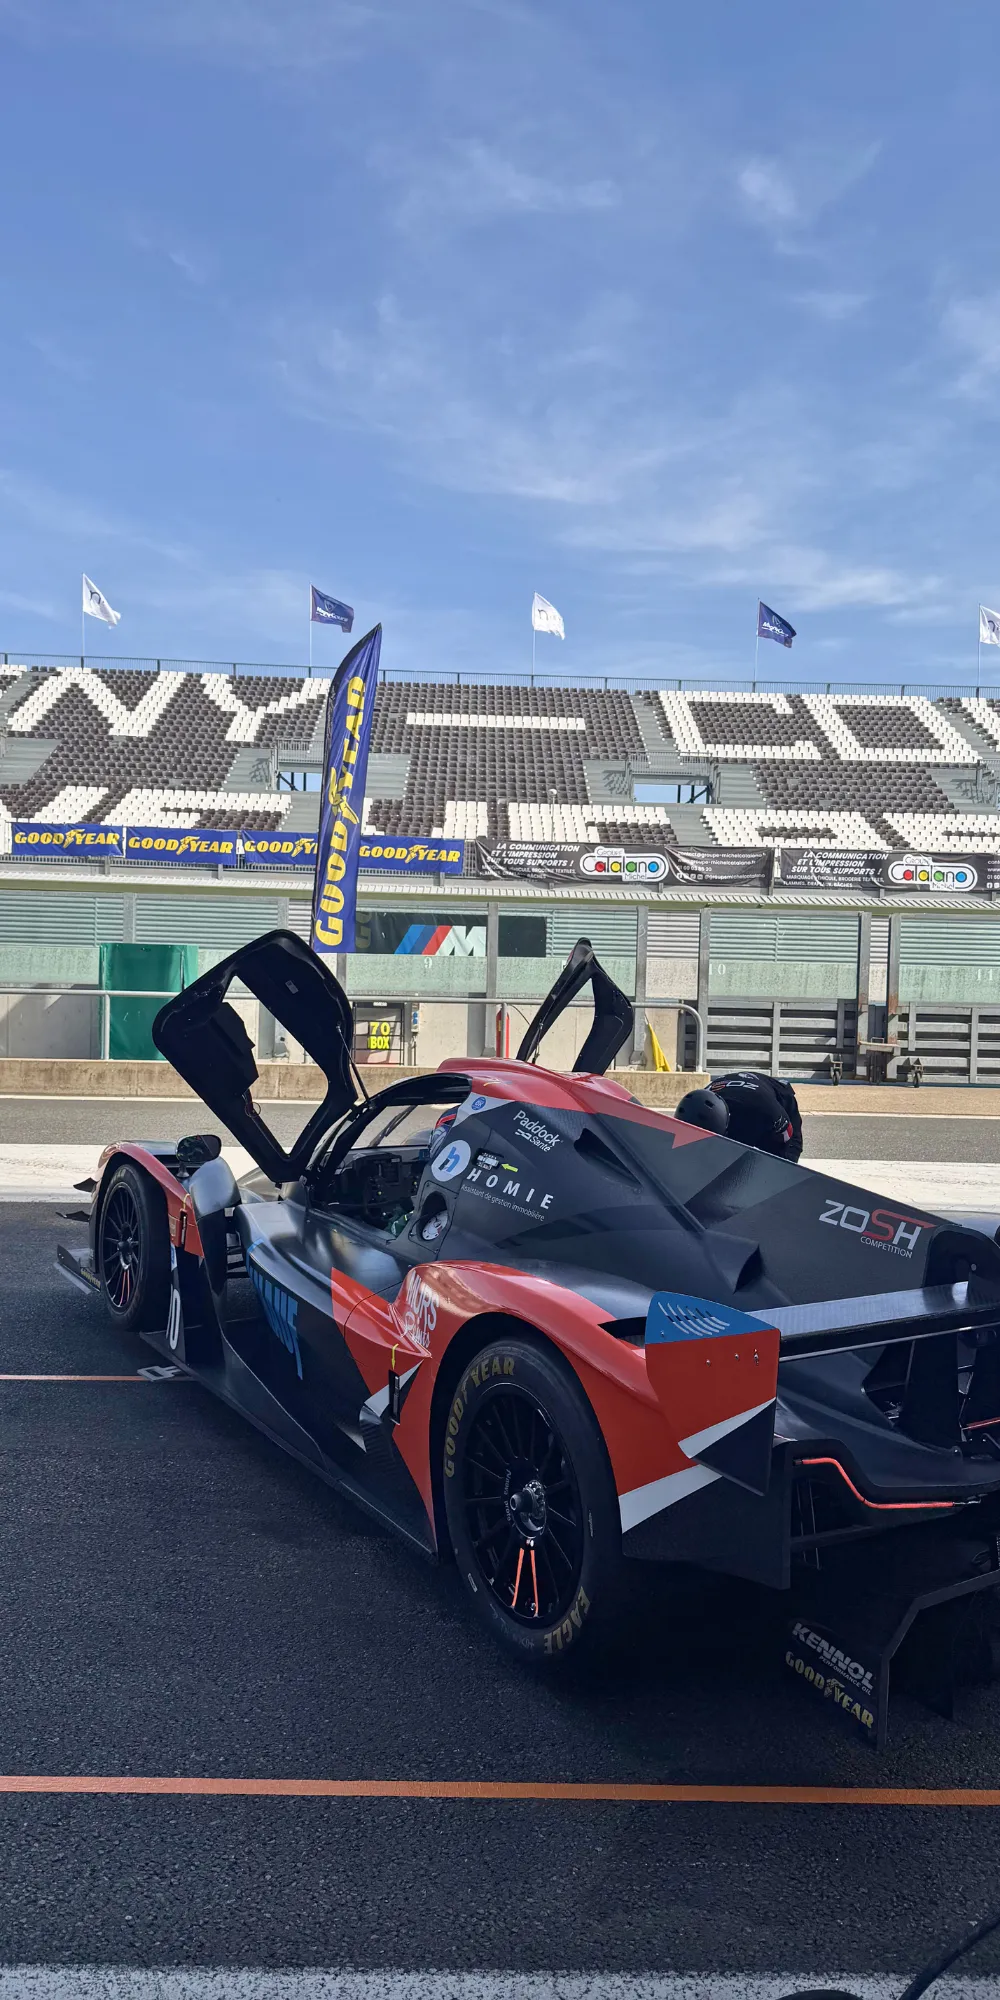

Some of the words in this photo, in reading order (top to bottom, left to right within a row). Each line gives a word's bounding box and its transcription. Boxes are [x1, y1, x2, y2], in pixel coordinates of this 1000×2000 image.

[0, 664, 332, 742] NY
[315, 676, 366, 947] GOODYEAR
[14, 828, 120, 848] GOODYEAR
[128, 836, 234, 855] GOODYEAR
[244, 838, 317, 858] GOODY
[359, 845, 461, 863] GOODYEAR
[502, 851, 558, 859] L'IMPRESSION
[509, 844, 581, 852] COMMUNICATION
[803, 851, 814, 859] LA
[815, 852, 889, 860] COMMUNICATION
[503, 858, 525, 866] TOUS
[526, 859, 569, 867] SUPPORTS
[797, 858, 807, 866] ET
[810, 866, 831, 874] TOUS
[832, 867, 875, 876] SUPPORTS
[424, 957, 433, 969] 9
[709, 963, 727, 976] 10
[977, 968, 993, 981] 11
[369, 1021, 391, 1036] 70
[370, 1036, 390, 1050] BOX
[513, 1110, 560, 1148] Paddock
[529, 1135, 552, 1152] Santé
[461, 1184, 485, 1198] Assistant
[491, 1197, 512, 1209] gestion
[466, 1168, 554, 1209] HOMIE
[819, 1199, 937, 1250] ZOSH
[860, 1236, 913, 1259] COMPETITION
[445, 1356, 515, 1478] GOODYEAR
[544, 1585, 590, 1654] EAGLE
[792, 1622, 874, 1690] KENNOL
[819, 1655, 861, 1688] PERFORMANCE
[861, 1685, 872, 1696] OIL
[785, 1651, 874, 1729] GOODYEAR
